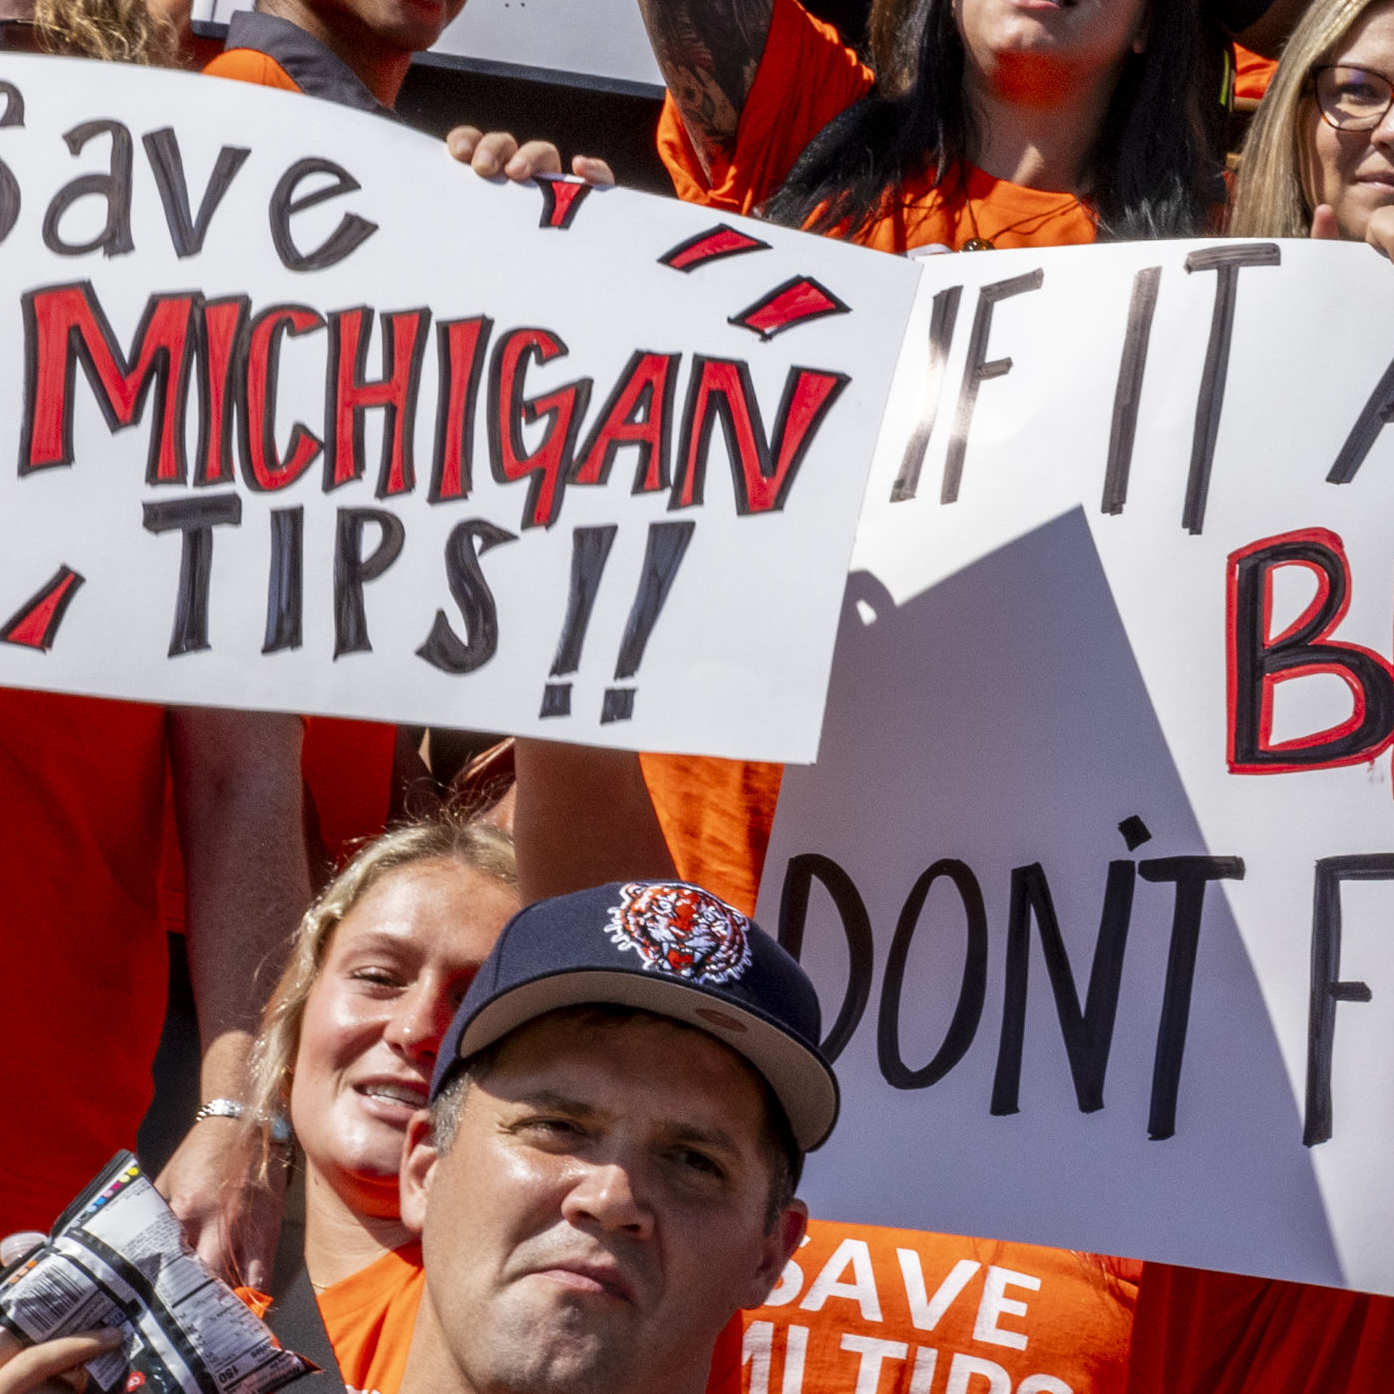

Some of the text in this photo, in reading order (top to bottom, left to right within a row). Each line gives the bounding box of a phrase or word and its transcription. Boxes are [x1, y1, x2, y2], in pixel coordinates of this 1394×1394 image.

[18, 279, 852, 530] MICHIGAN
[890, 267, 1043, 505] IF
[1100, 243, 1283, 535] IT
[142, 492, 696, 726] TIPS!!
[774, 815, 1245, 1140] DON'T
